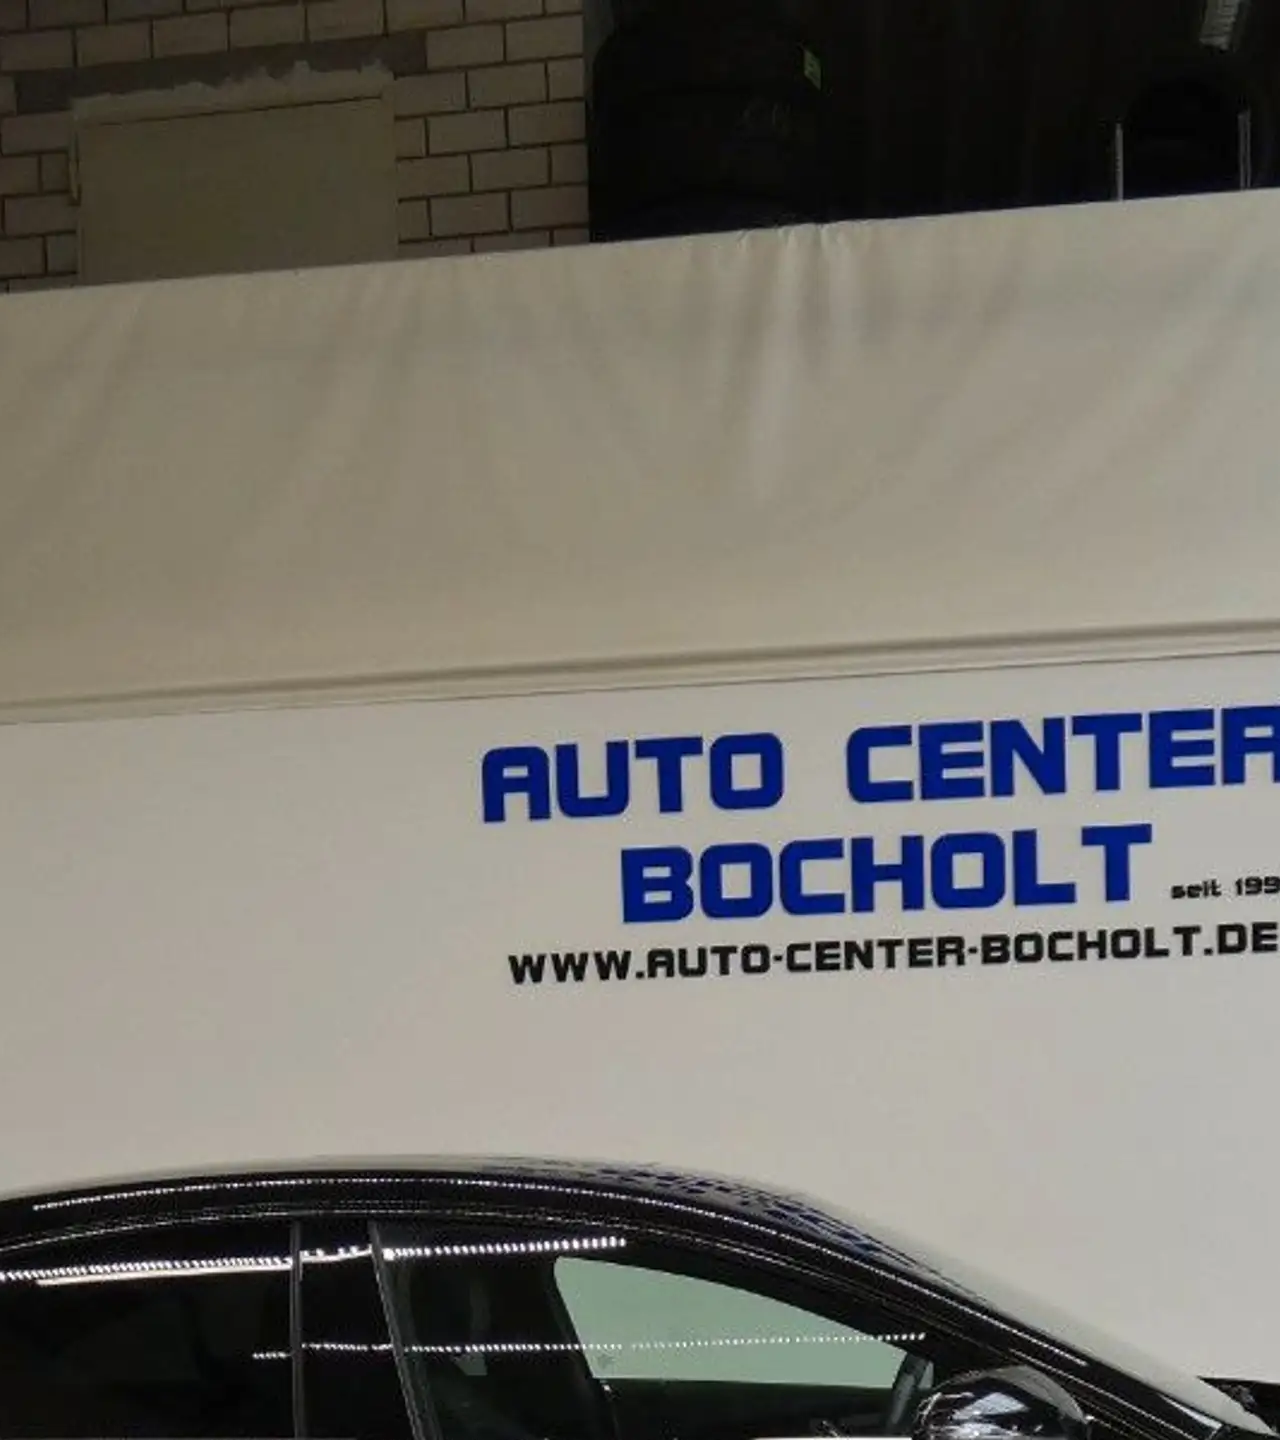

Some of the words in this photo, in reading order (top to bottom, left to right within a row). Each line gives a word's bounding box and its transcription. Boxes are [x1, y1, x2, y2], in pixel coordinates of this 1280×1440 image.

[481, 731, 784, 823] AUTO
[620, 823, 1153, 924] BOCHOLT
[1170, 878, 1222, 900] seit
[507, 921, 1279, 985] WWW.AUTO-CENTER-BOCHOLT.DE
